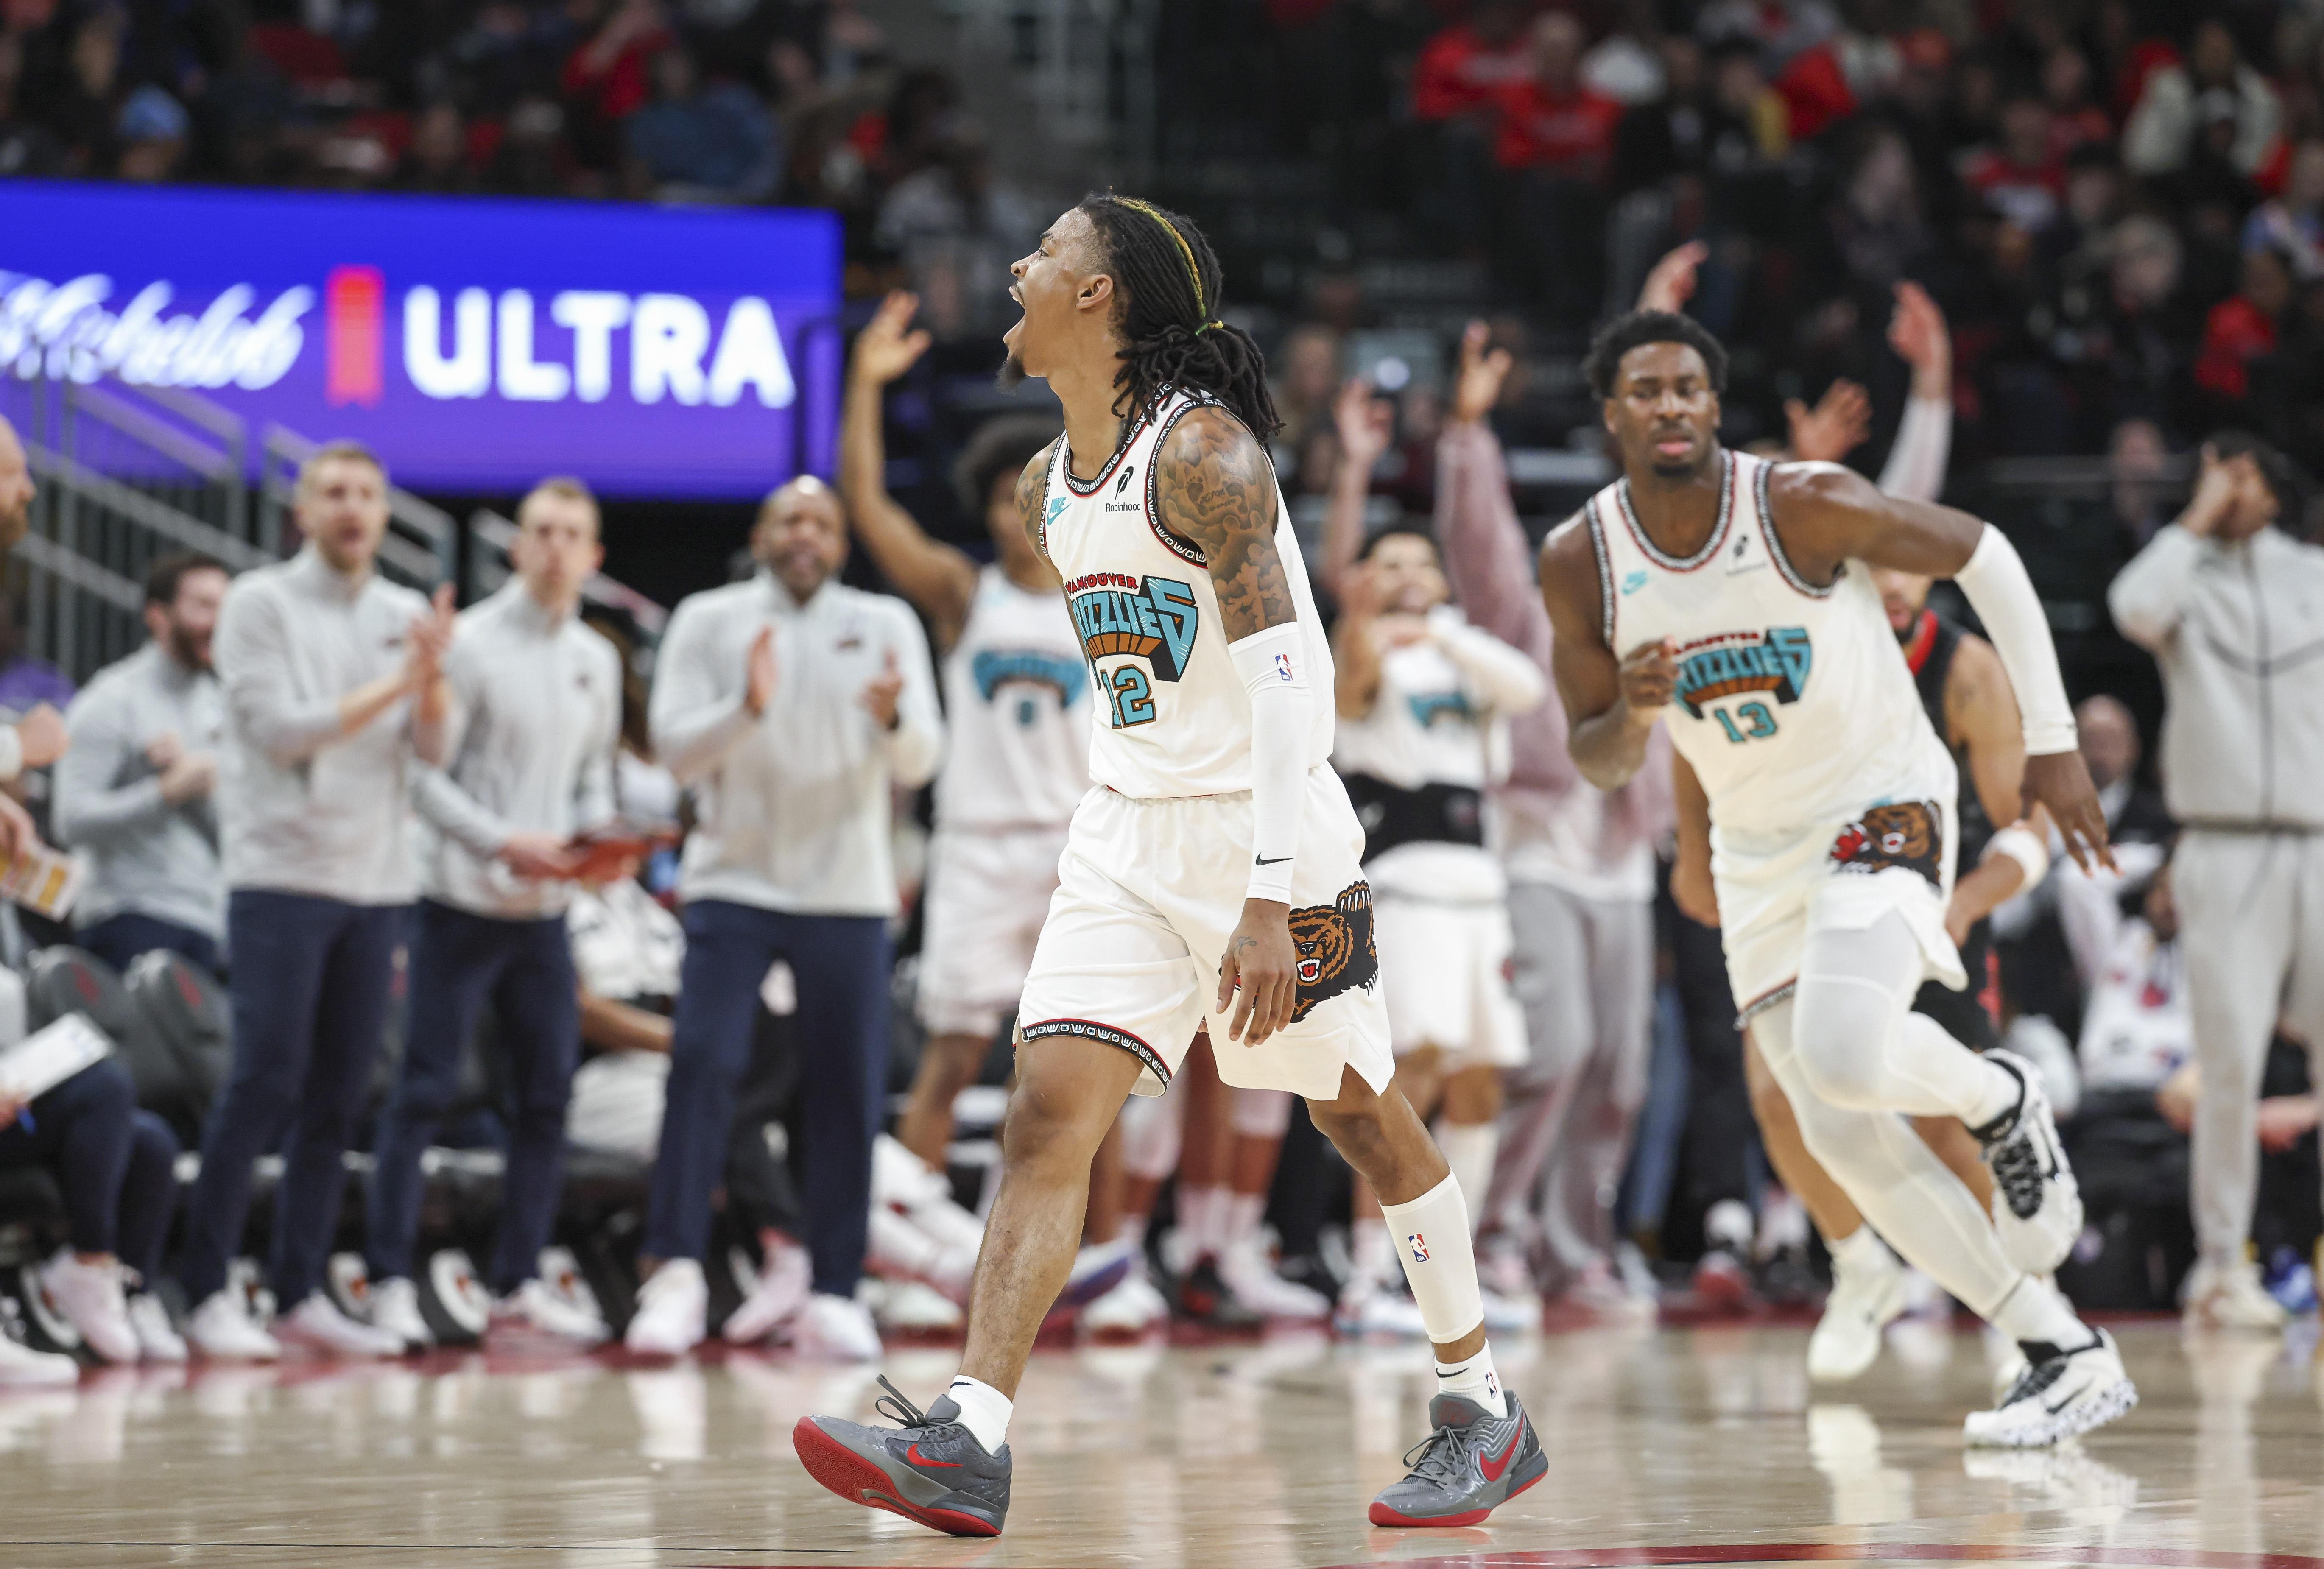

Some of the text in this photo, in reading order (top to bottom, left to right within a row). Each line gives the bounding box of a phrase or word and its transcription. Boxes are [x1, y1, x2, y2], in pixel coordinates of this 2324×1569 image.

[403, 285, 796, 409] ULTRA
[1106, 501, 1141, 512] Robinhood
[1065, 572, 1139, 596] VANCOUVER
[1100, 664, 1156, 729] 12
[1714, 702, 1777, 743] 13
